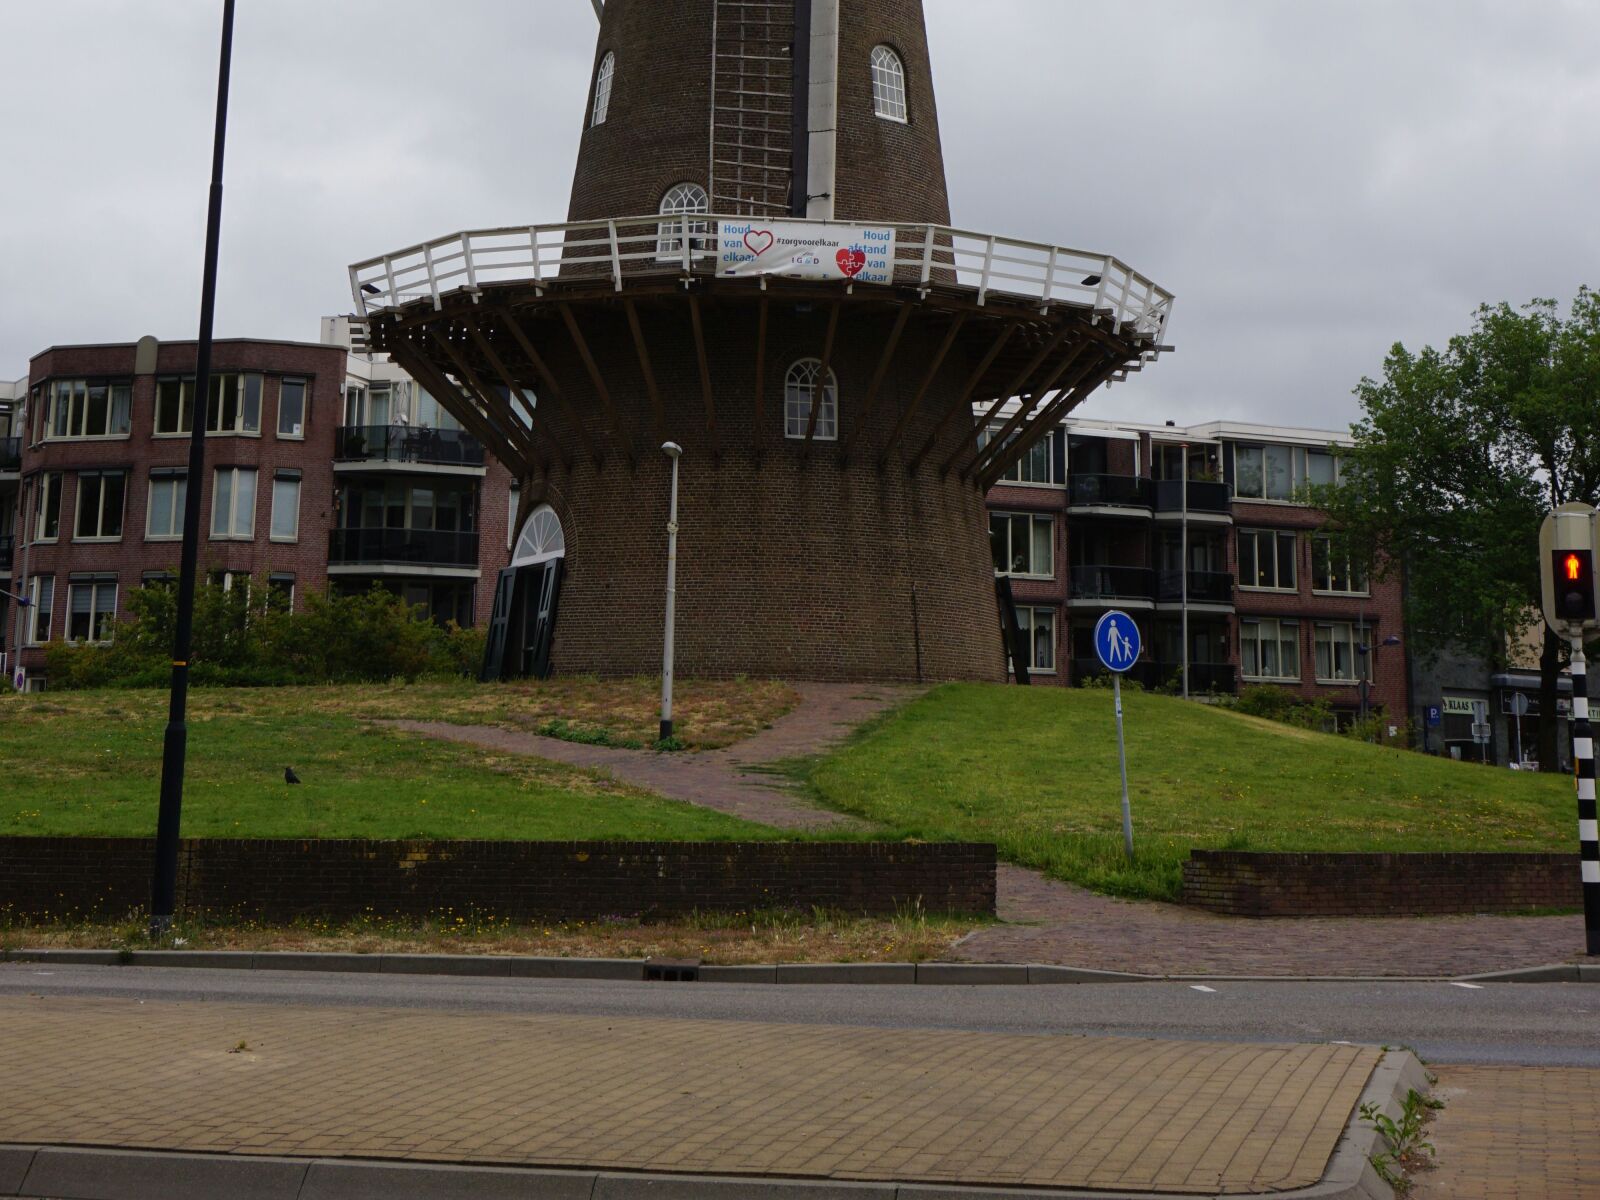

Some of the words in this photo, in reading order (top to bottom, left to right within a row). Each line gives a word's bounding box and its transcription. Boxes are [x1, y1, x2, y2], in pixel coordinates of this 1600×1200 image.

[723, 224, 751, 234] Houd
[863, 230, 890, 241] Houd
[723, 240, 743, 248] van
[776, 237, 840, 248] #zorgvoorelkaar
[848, 243, 887, 254] afstand
[723, 252, 755, 262] elkaar
[867, 260, 886, 268] van
[855, 272, 888, 282] elkaar
[1448, 700, 1470, 711] KLAAS
